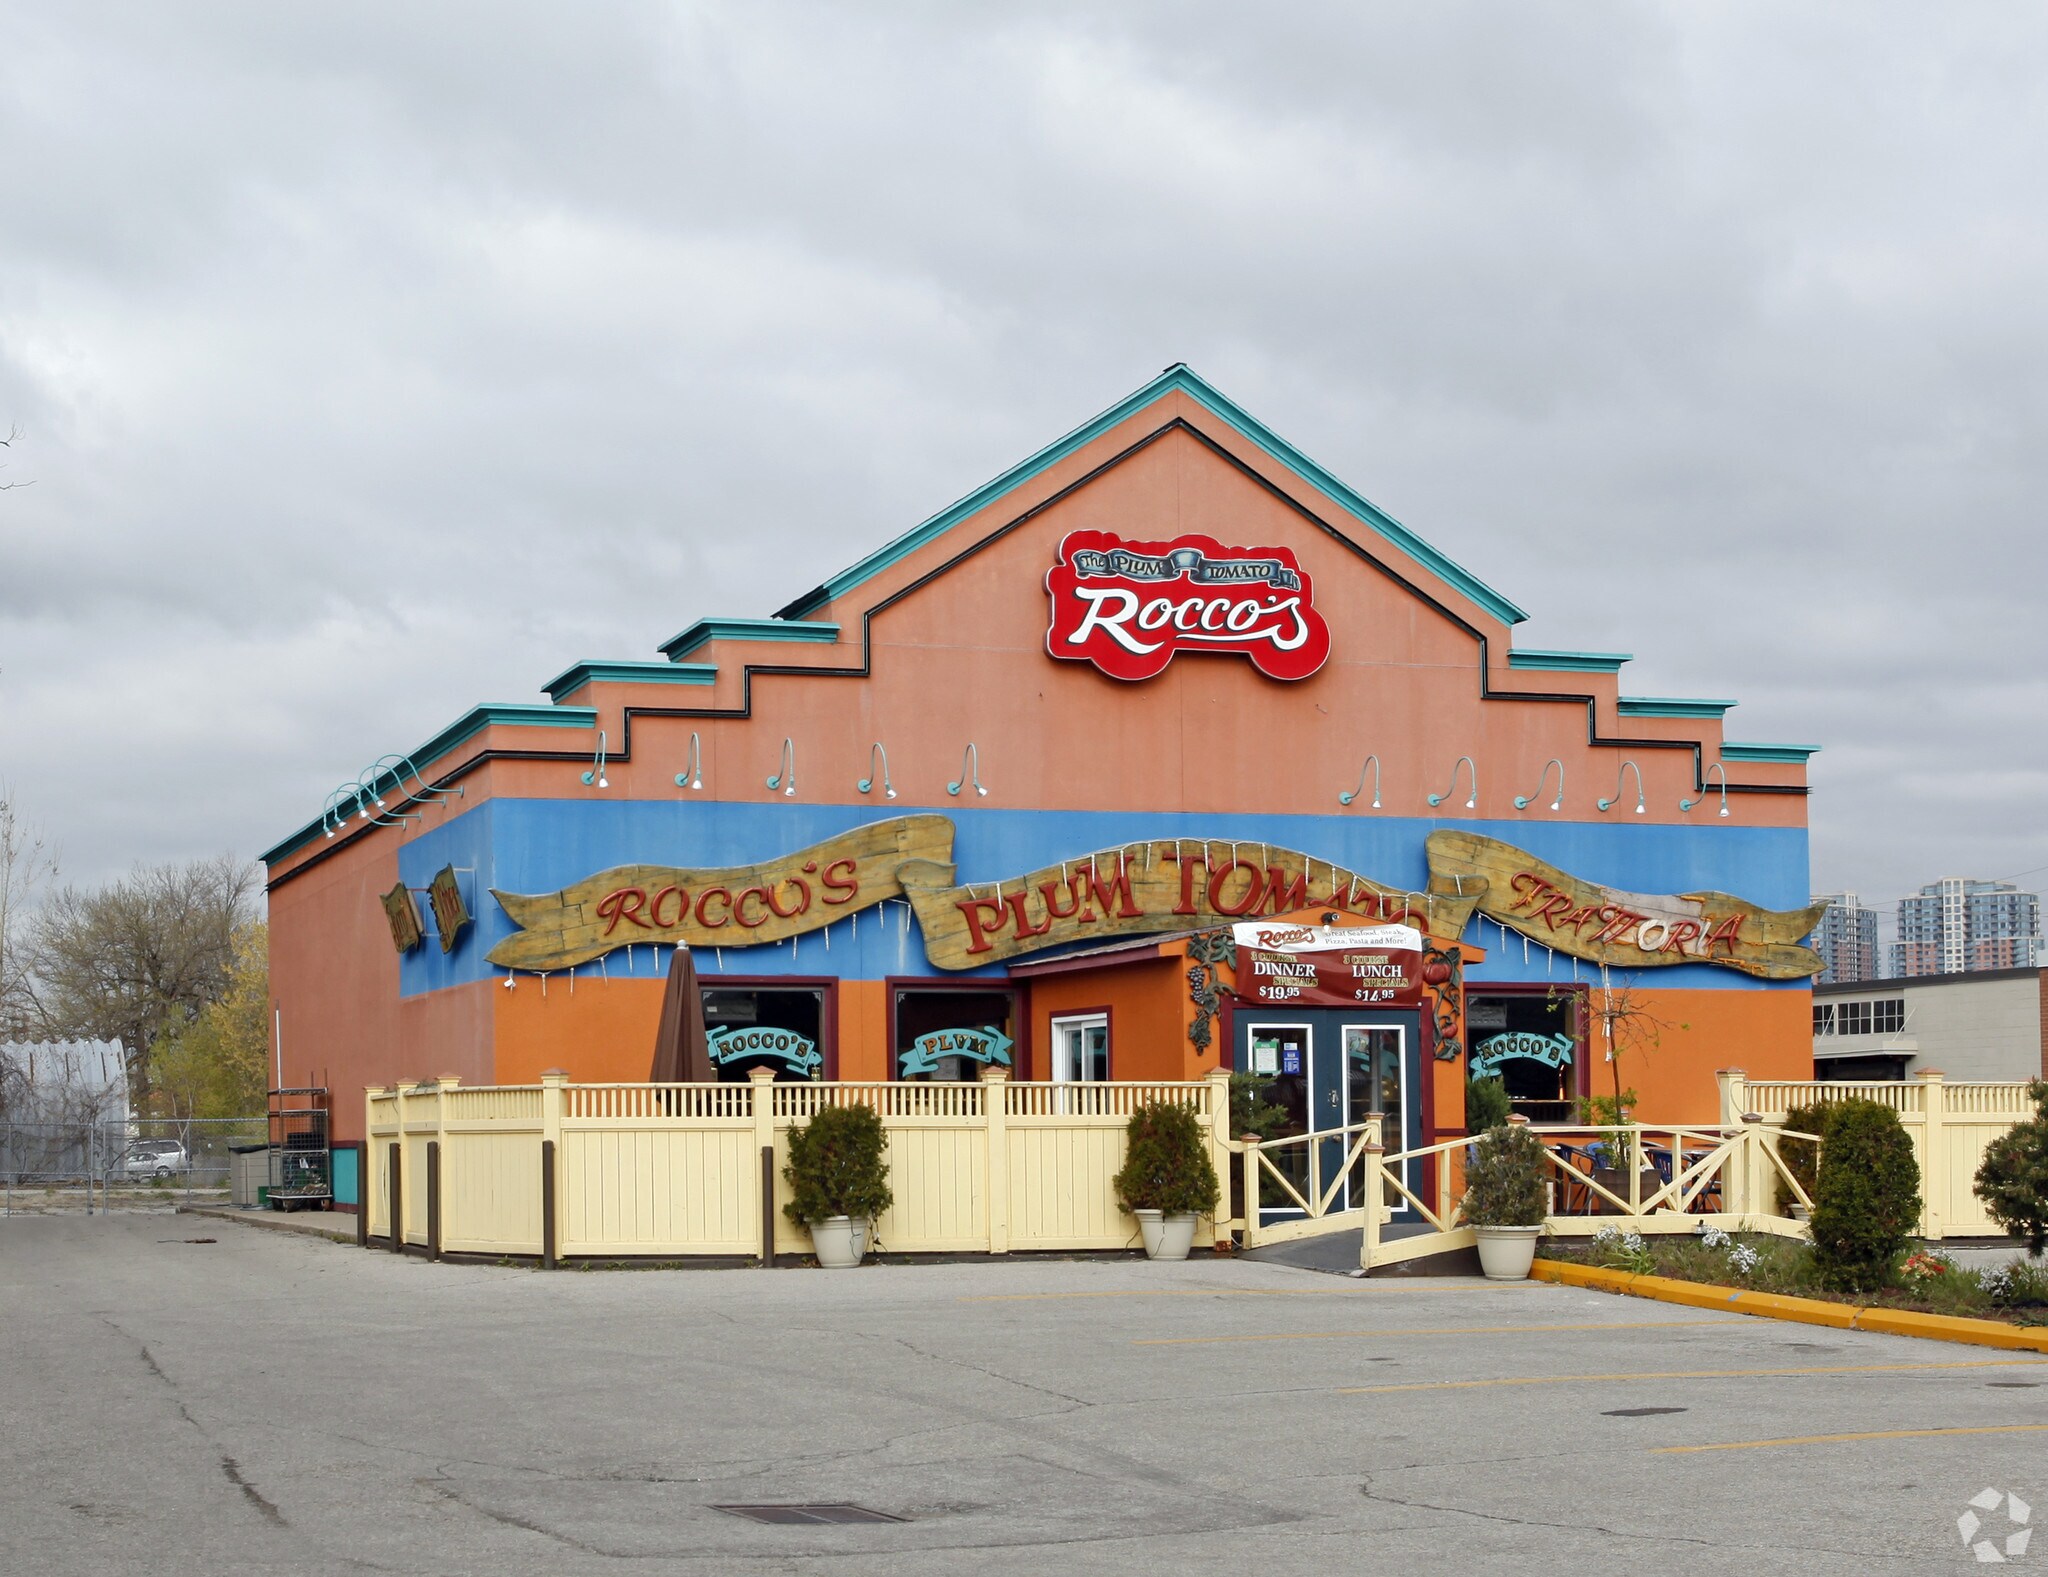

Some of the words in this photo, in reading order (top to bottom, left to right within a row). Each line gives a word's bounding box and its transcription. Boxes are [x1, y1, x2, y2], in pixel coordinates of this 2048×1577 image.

[1115, 556, 1165, 575] PLUM
[1207, 565, 1271, 578] TOMATO
[596, 858, 858, 936] ROCCO'S
[954, 853, 1145, 955] PLUM
[1511, 871, 1748, 957] TRATTORIA
[1349, 937, 1369, 945] Pasta
[1253, 961, 1316, 977] DINNER
[1352, 964, 1402, 978] LUNCH
[1273, 976, 1318, 987] SPECIALS
[1363, 978, 1409, 987] SPECIALS
[1259, 985, 1300, 1000] $19.95
[1354, 988, 1395, 1002] $14.95
[717, 1032, 809, 1058] ROCCO'S
[1480, 1037, 1561, 1061] ROCCO'S
